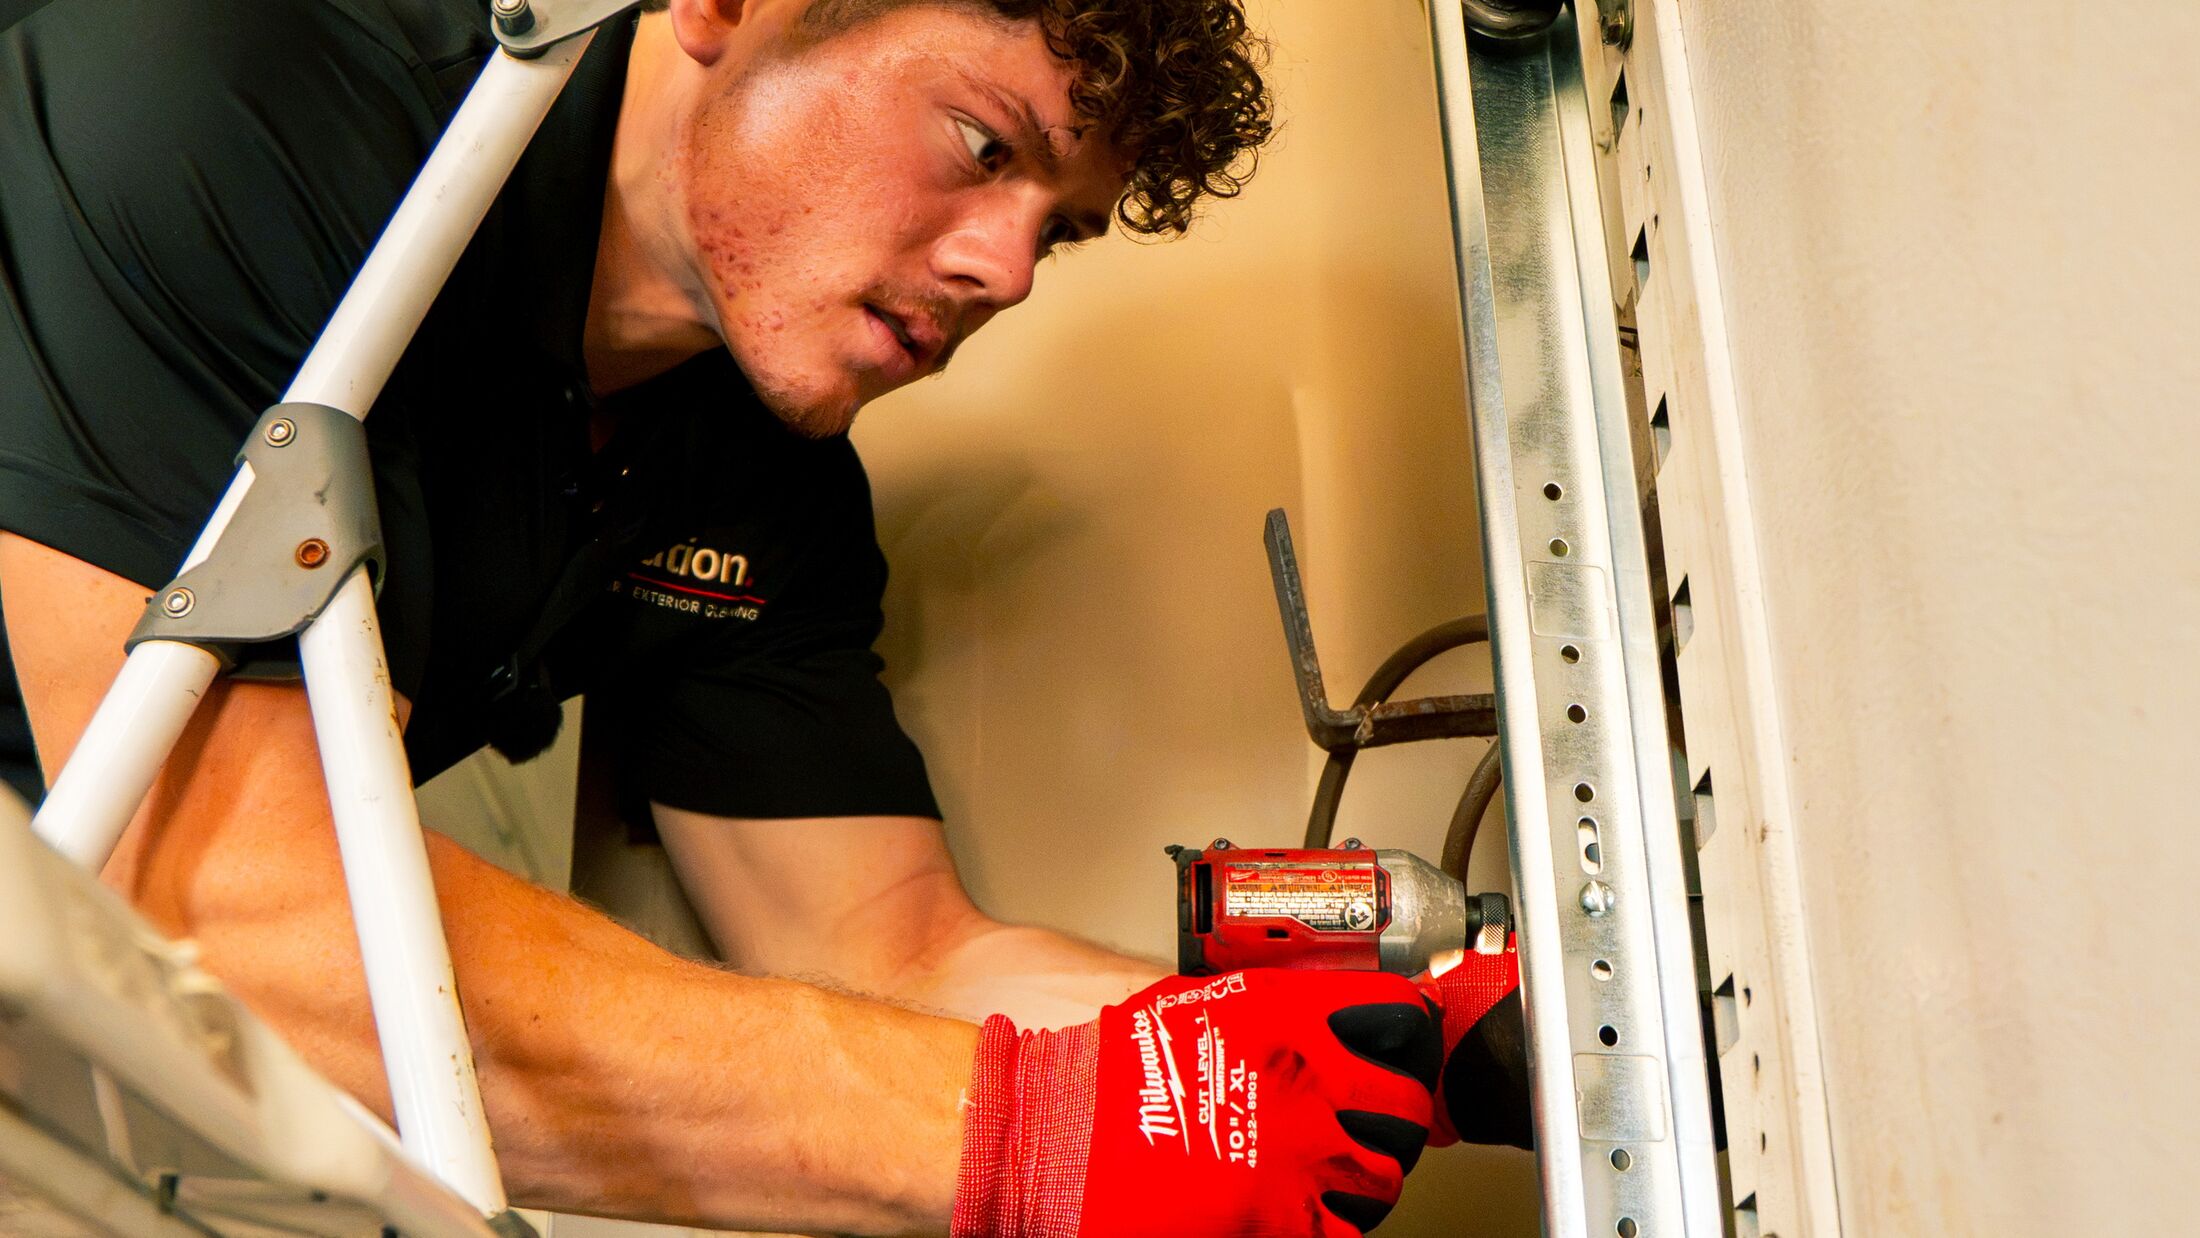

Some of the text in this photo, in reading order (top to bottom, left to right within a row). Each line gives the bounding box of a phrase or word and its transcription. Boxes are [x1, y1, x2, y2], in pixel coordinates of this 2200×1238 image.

[633, 587, 700, 613] EXTERIOR
[1130, 1009, 1179, 1146] Milwaukee
[1195, 1016, 1209, 1125] CUT LEVEL 1
[1229, 1059, 1245, 1092] XL
